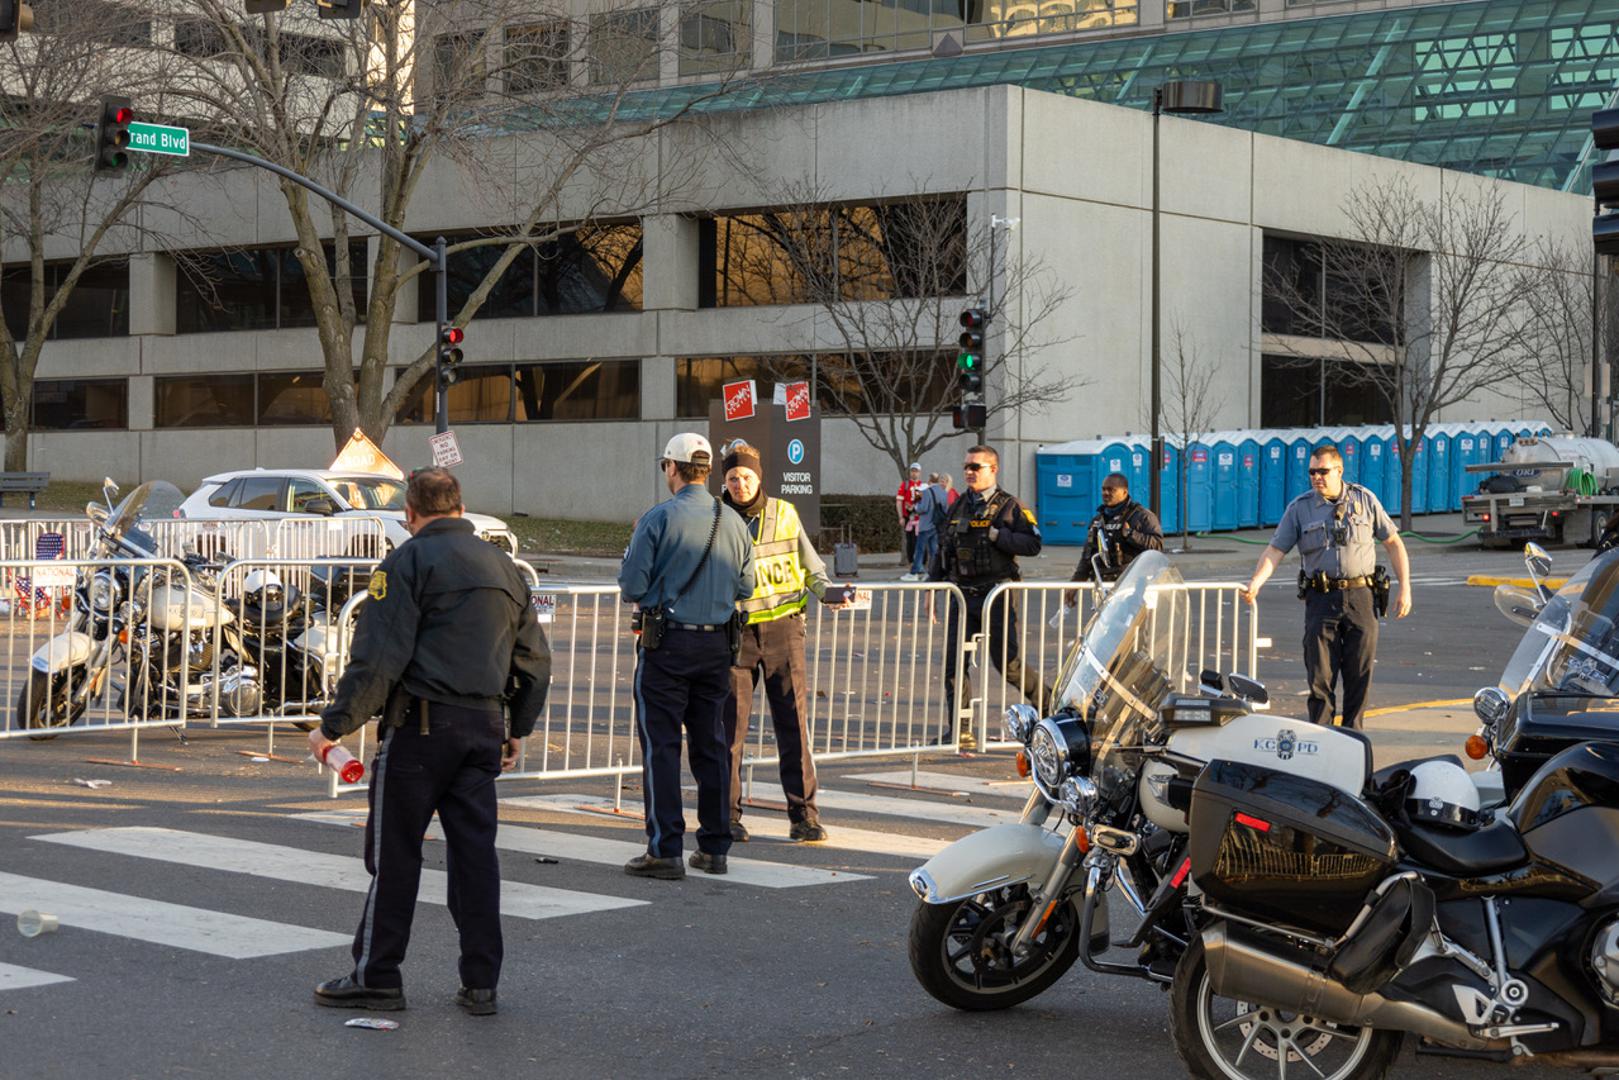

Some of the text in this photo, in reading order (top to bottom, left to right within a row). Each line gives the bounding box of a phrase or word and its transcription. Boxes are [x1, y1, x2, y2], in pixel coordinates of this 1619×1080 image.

[128, 131, 186, 149] rand Blvd
[783, 472, 811, 482] VISITOR
[781, 485, 813, 494] PARKING
[36, 566, 75, 576] NATIONAL
[531, 595, 554, 606] ONAL
[1253, 739, 1318, 753] KC PD
